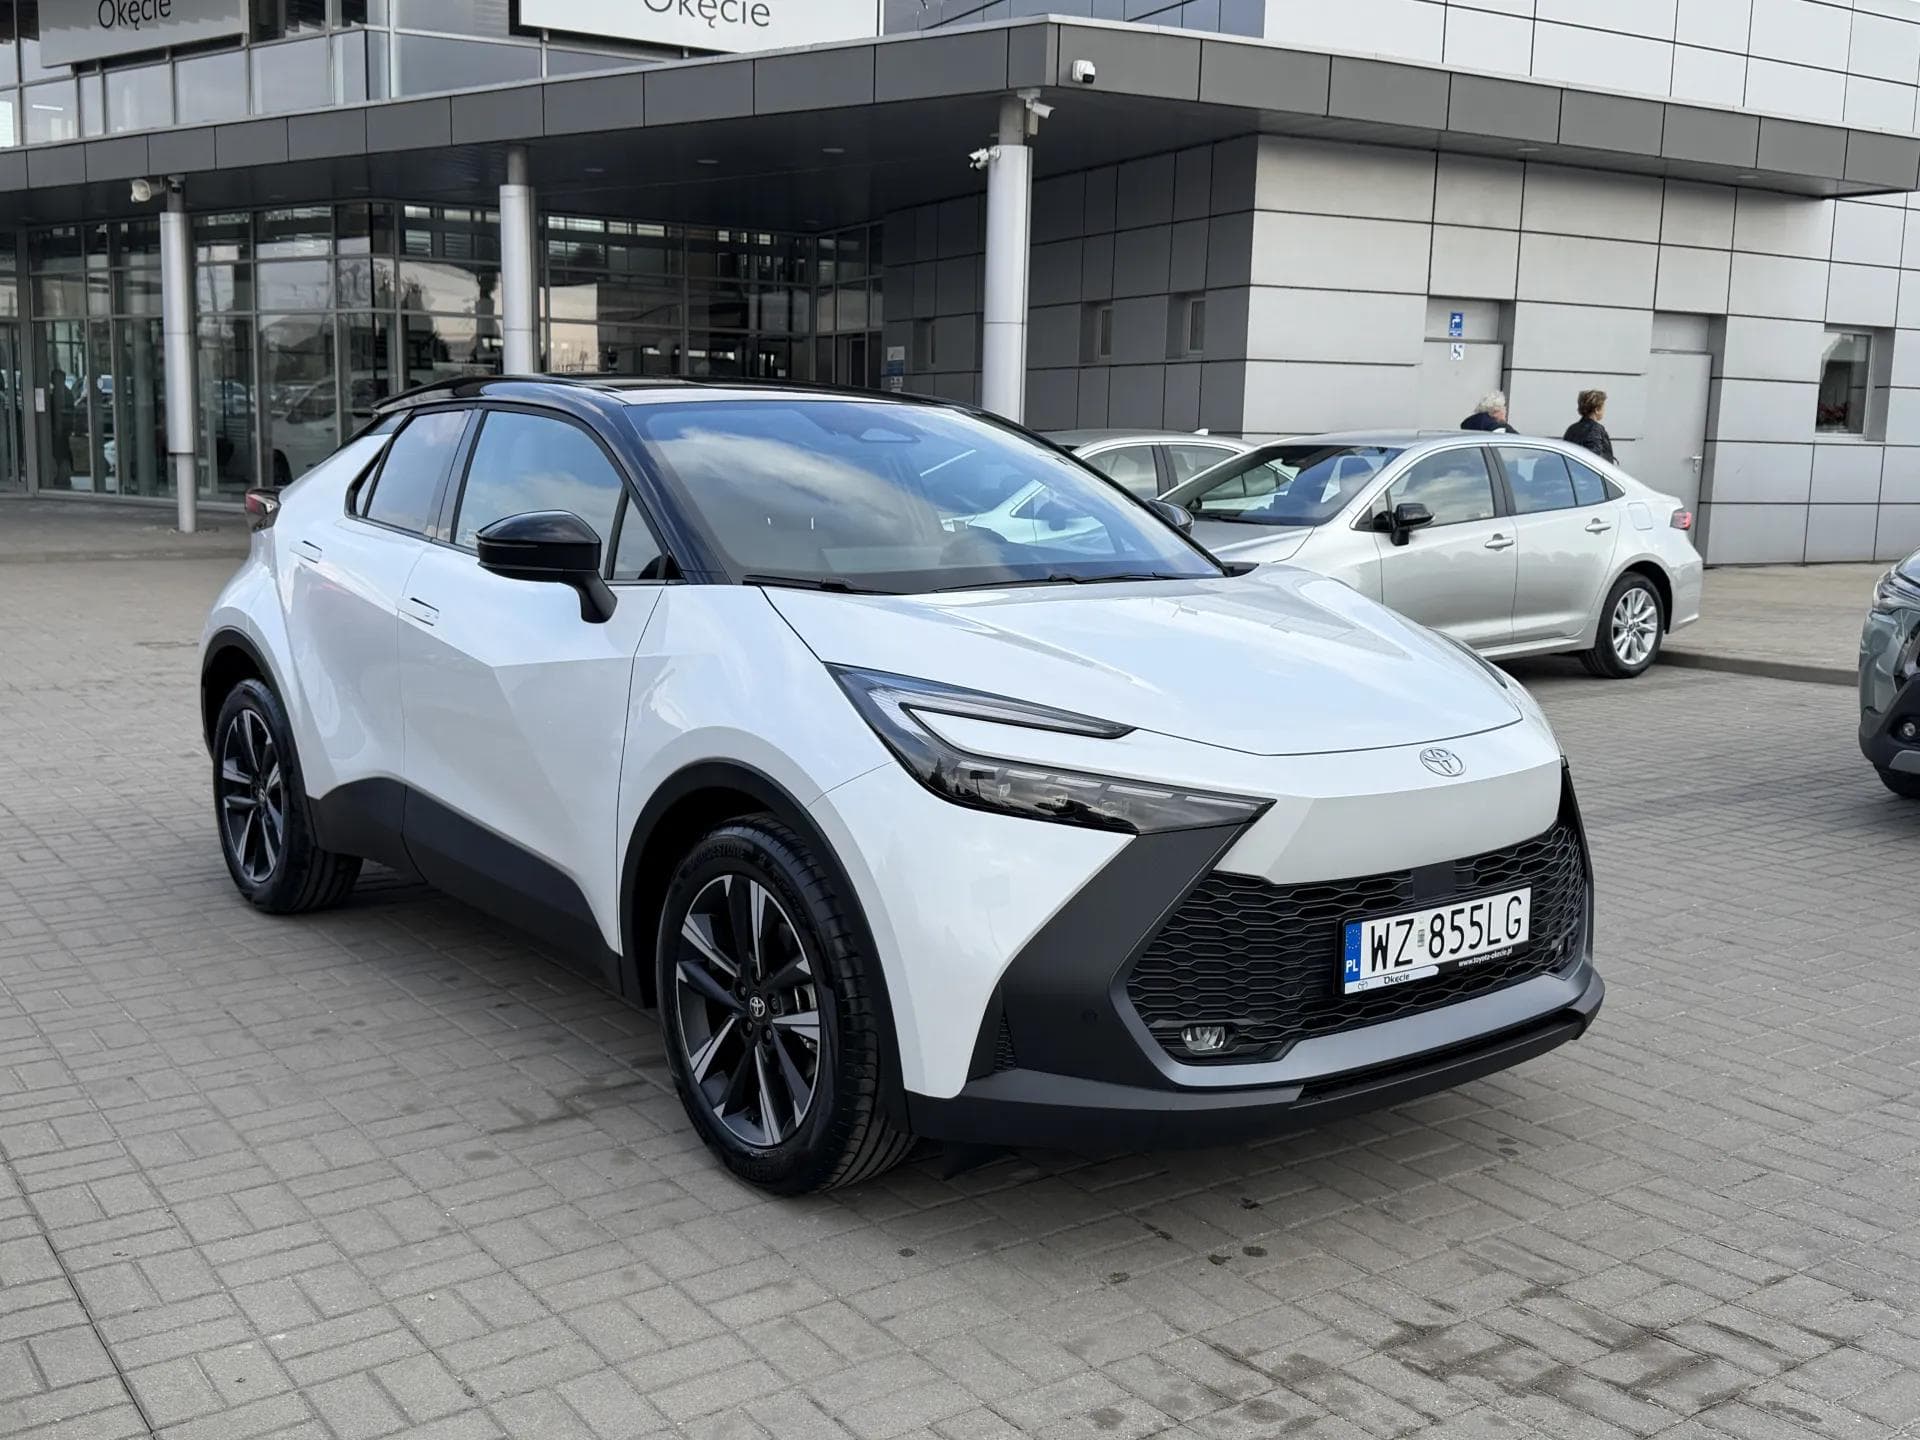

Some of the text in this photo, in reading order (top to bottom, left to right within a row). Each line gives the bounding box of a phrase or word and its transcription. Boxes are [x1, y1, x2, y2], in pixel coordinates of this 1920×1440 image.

[98, 0, 171, 31] Okęcie
[1371, 895, 1522, 972] WZ 855LG
[1345, 959, 1359, 973] PL
